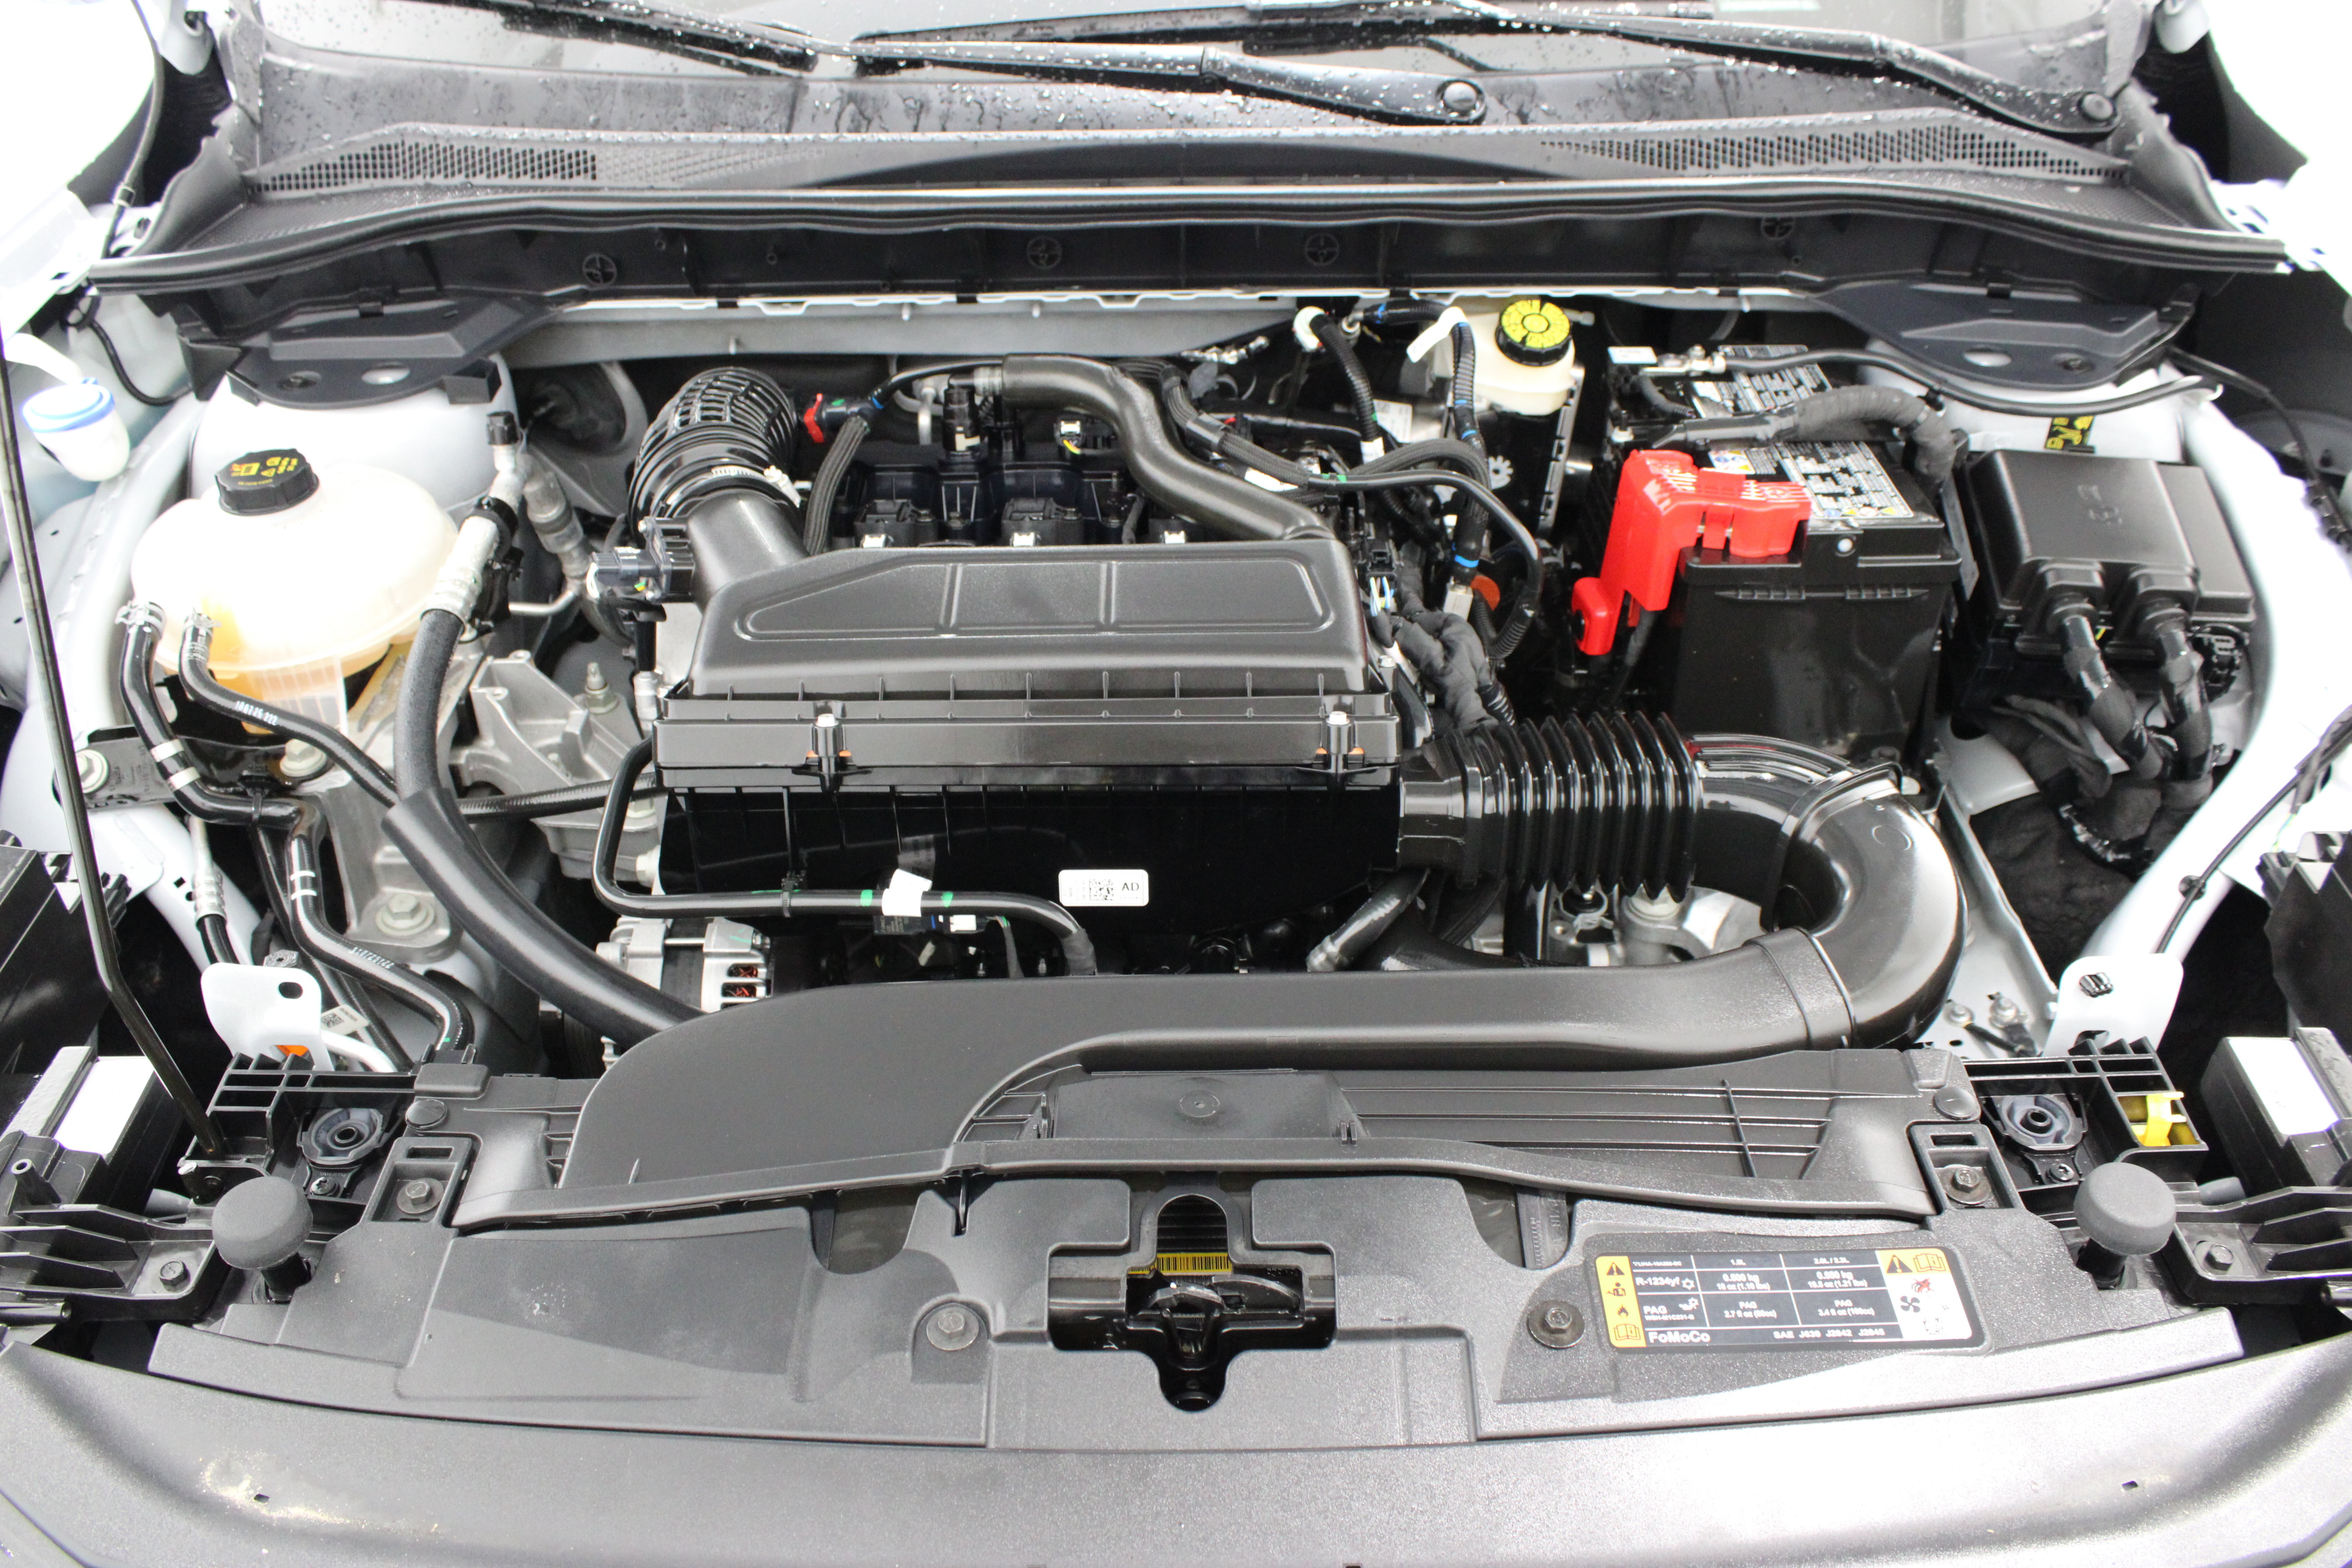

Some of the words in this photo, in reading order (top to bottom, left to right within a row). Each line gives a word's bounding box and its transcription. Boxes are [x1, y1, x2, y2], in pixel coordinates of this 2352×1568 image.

[1122, 882, 1139, 891] AD
[1747, 1273, 1760, 1283] kg
[1840, 1270, 1854, 1281] kg
[1635, 1276, 1680, 1287] R-1234yf
[1739, 1301, 1758, 1309] PAG
[1834, 1299, 1854, 1307] PAG
[1643, 1305, 1668, 1314] PAG
[1648, 1330, 1711, 1343] FoMoCo
[1773, 1330, 1795, 1339] SAE
